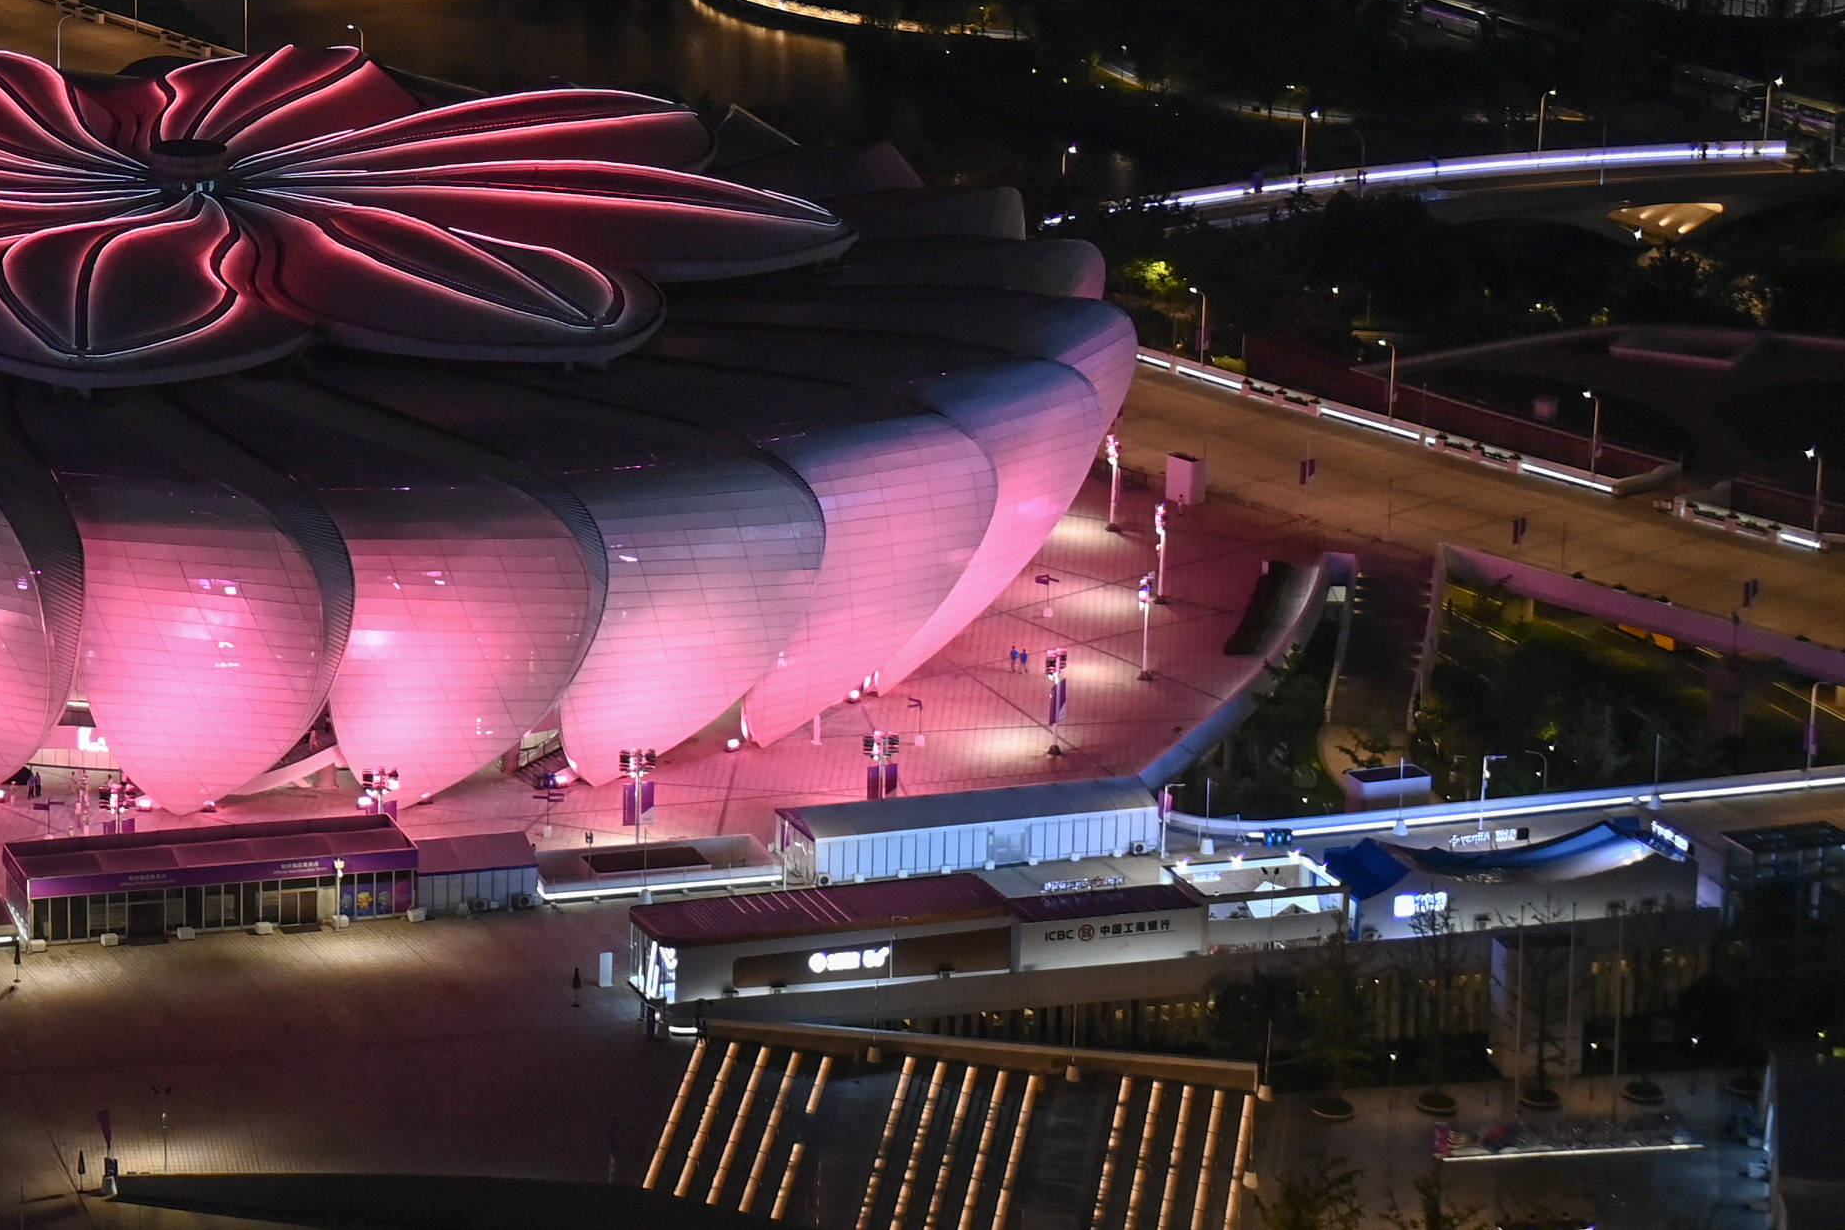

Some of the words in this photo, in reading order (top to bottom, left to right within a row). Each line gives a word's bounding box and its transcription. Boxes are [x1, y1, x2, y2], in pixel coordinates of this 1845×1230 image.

[1100, 919, 1171, 936] 中国工商银行
[1044, 929, 1074, 941] ICBC
